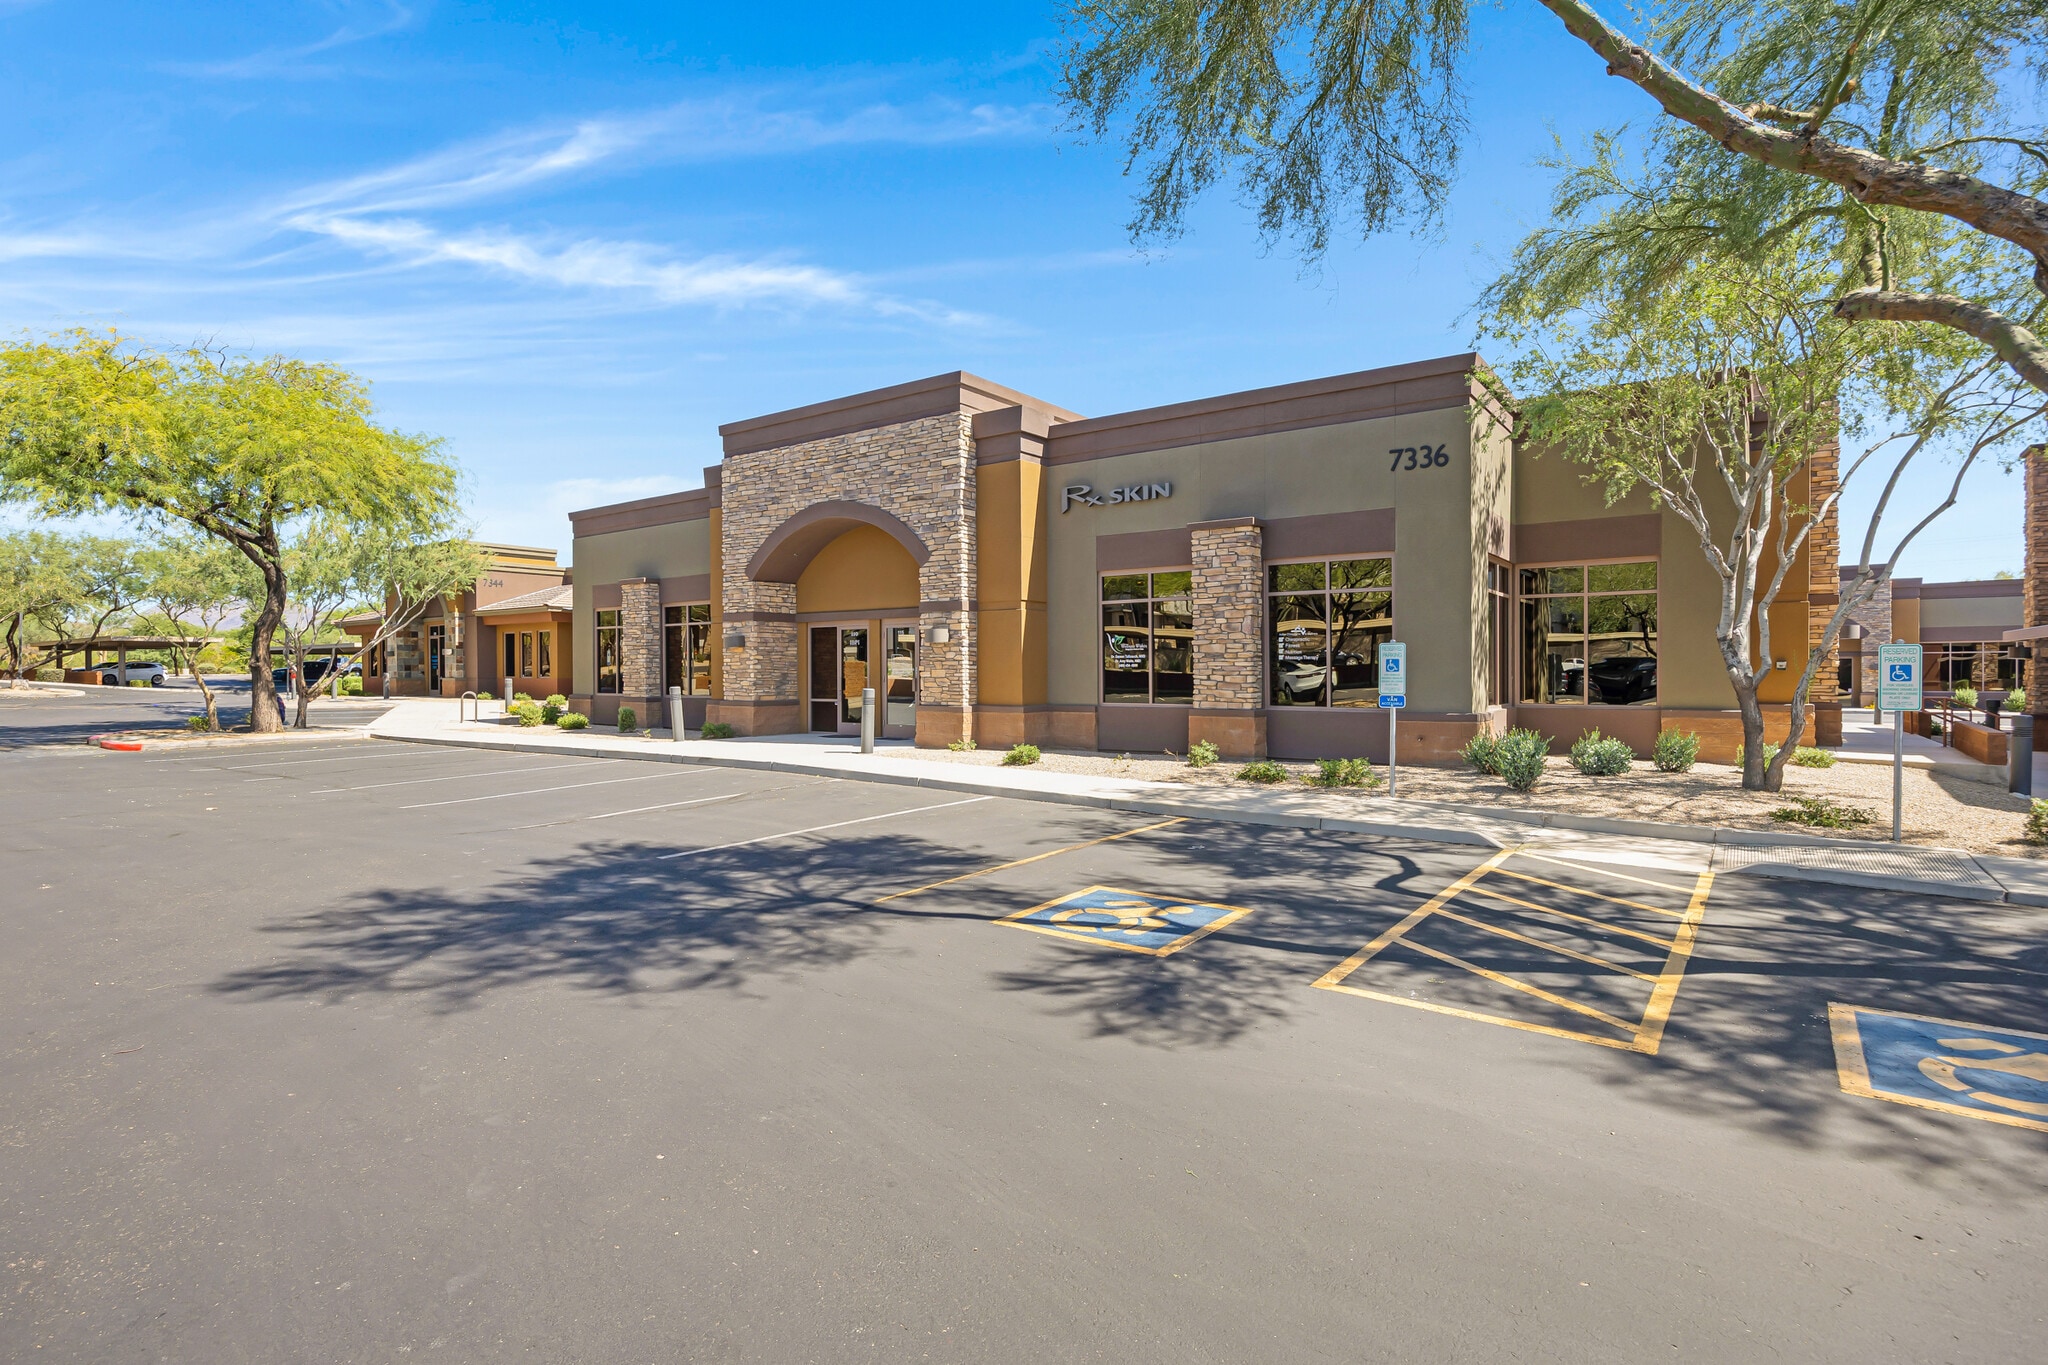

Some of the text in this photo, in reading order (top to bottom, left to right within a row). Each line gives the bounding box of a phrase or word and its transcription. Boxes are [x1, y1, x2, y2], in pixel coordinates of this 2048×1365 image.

[1389, 444, 1450, 472] 7336
[1109, 482, 1170, 505] SKIN
[483, 578, 504, 588] 7344
